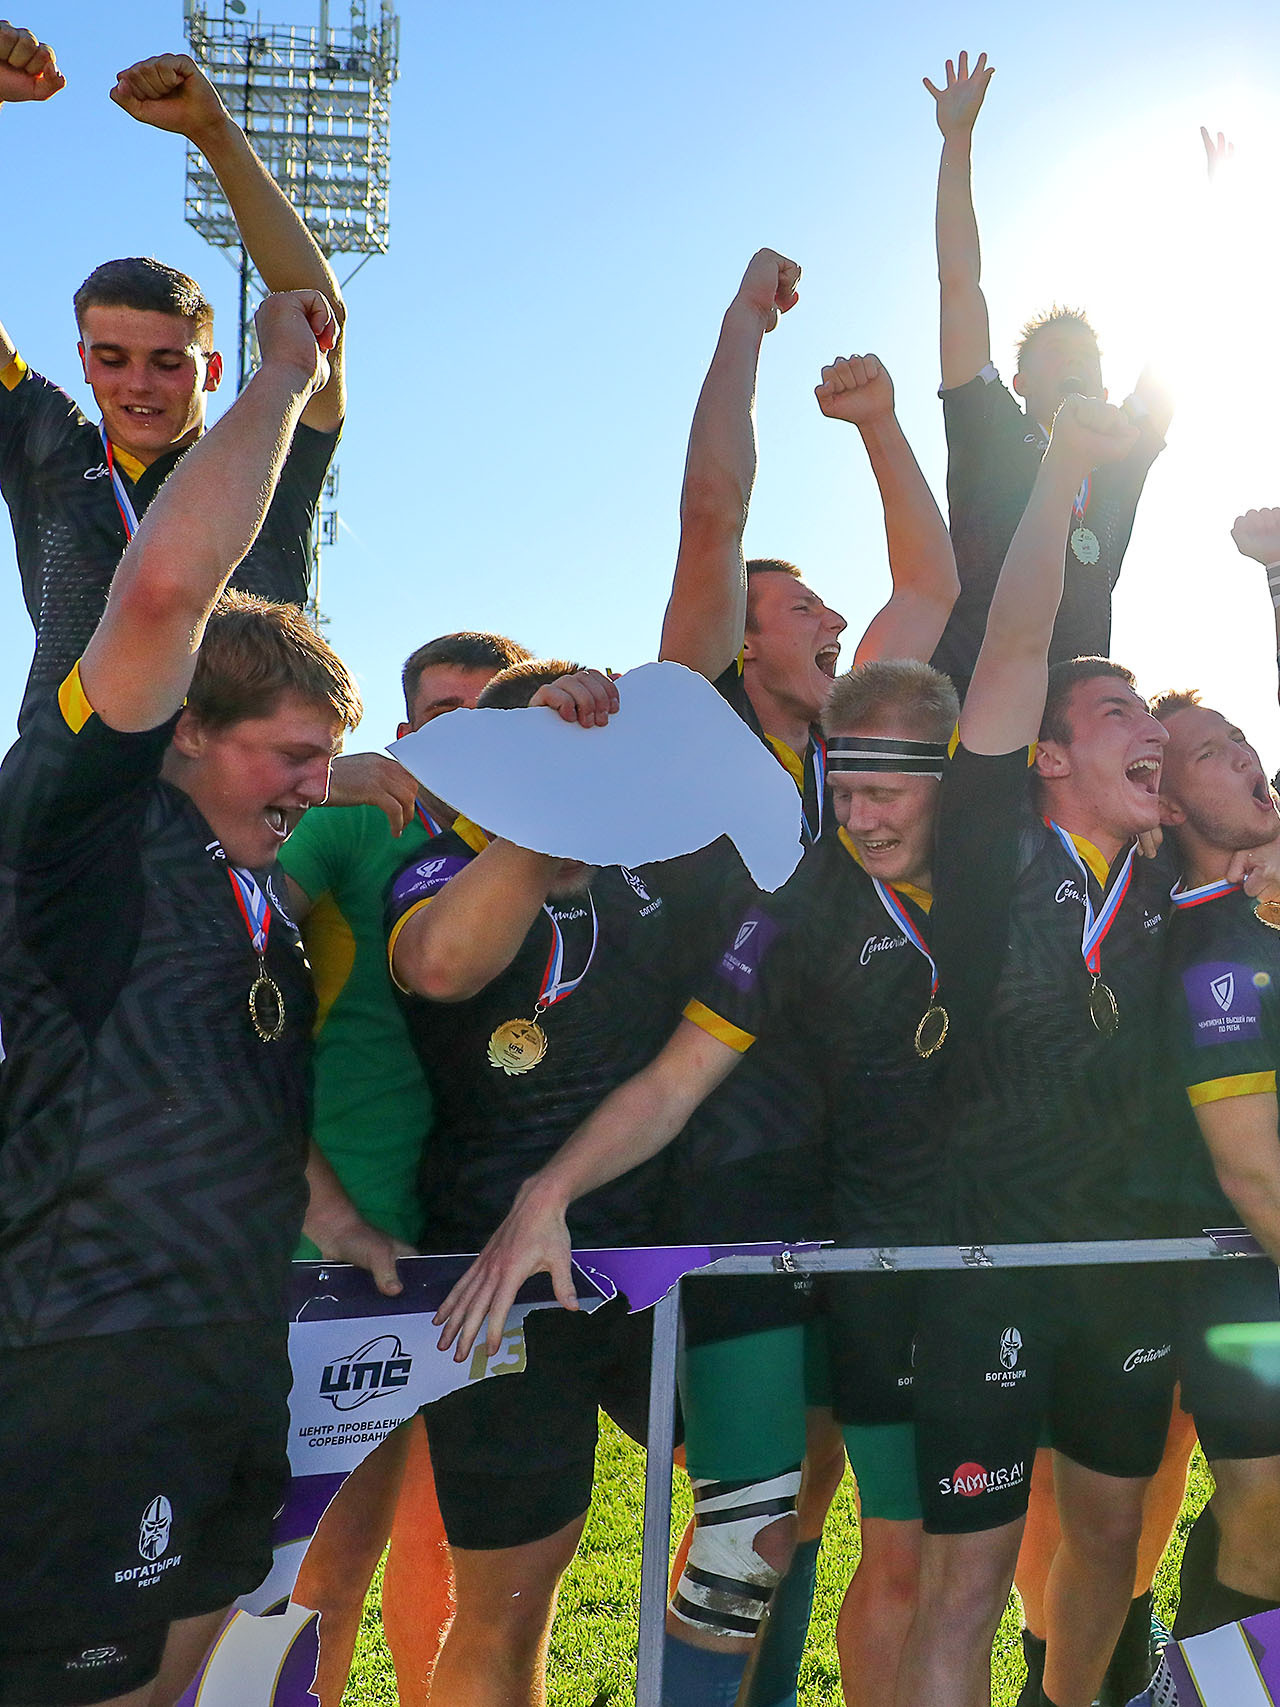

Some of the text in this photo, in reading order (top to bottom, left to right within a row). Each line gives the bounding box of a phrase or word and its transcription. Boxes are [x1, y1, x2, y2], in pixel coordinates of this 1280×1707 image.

[319, 1358, 413, 1394] ЦПС
[985, 1369, 1027, 1382] БОГАТЫРИ
[298, 1424, 334, 1437] ЦЕНТР
[939, 1461, 1024, 1495] SAMURAI
[115, 1555, 181, 1583] БОГАТЫРИ
